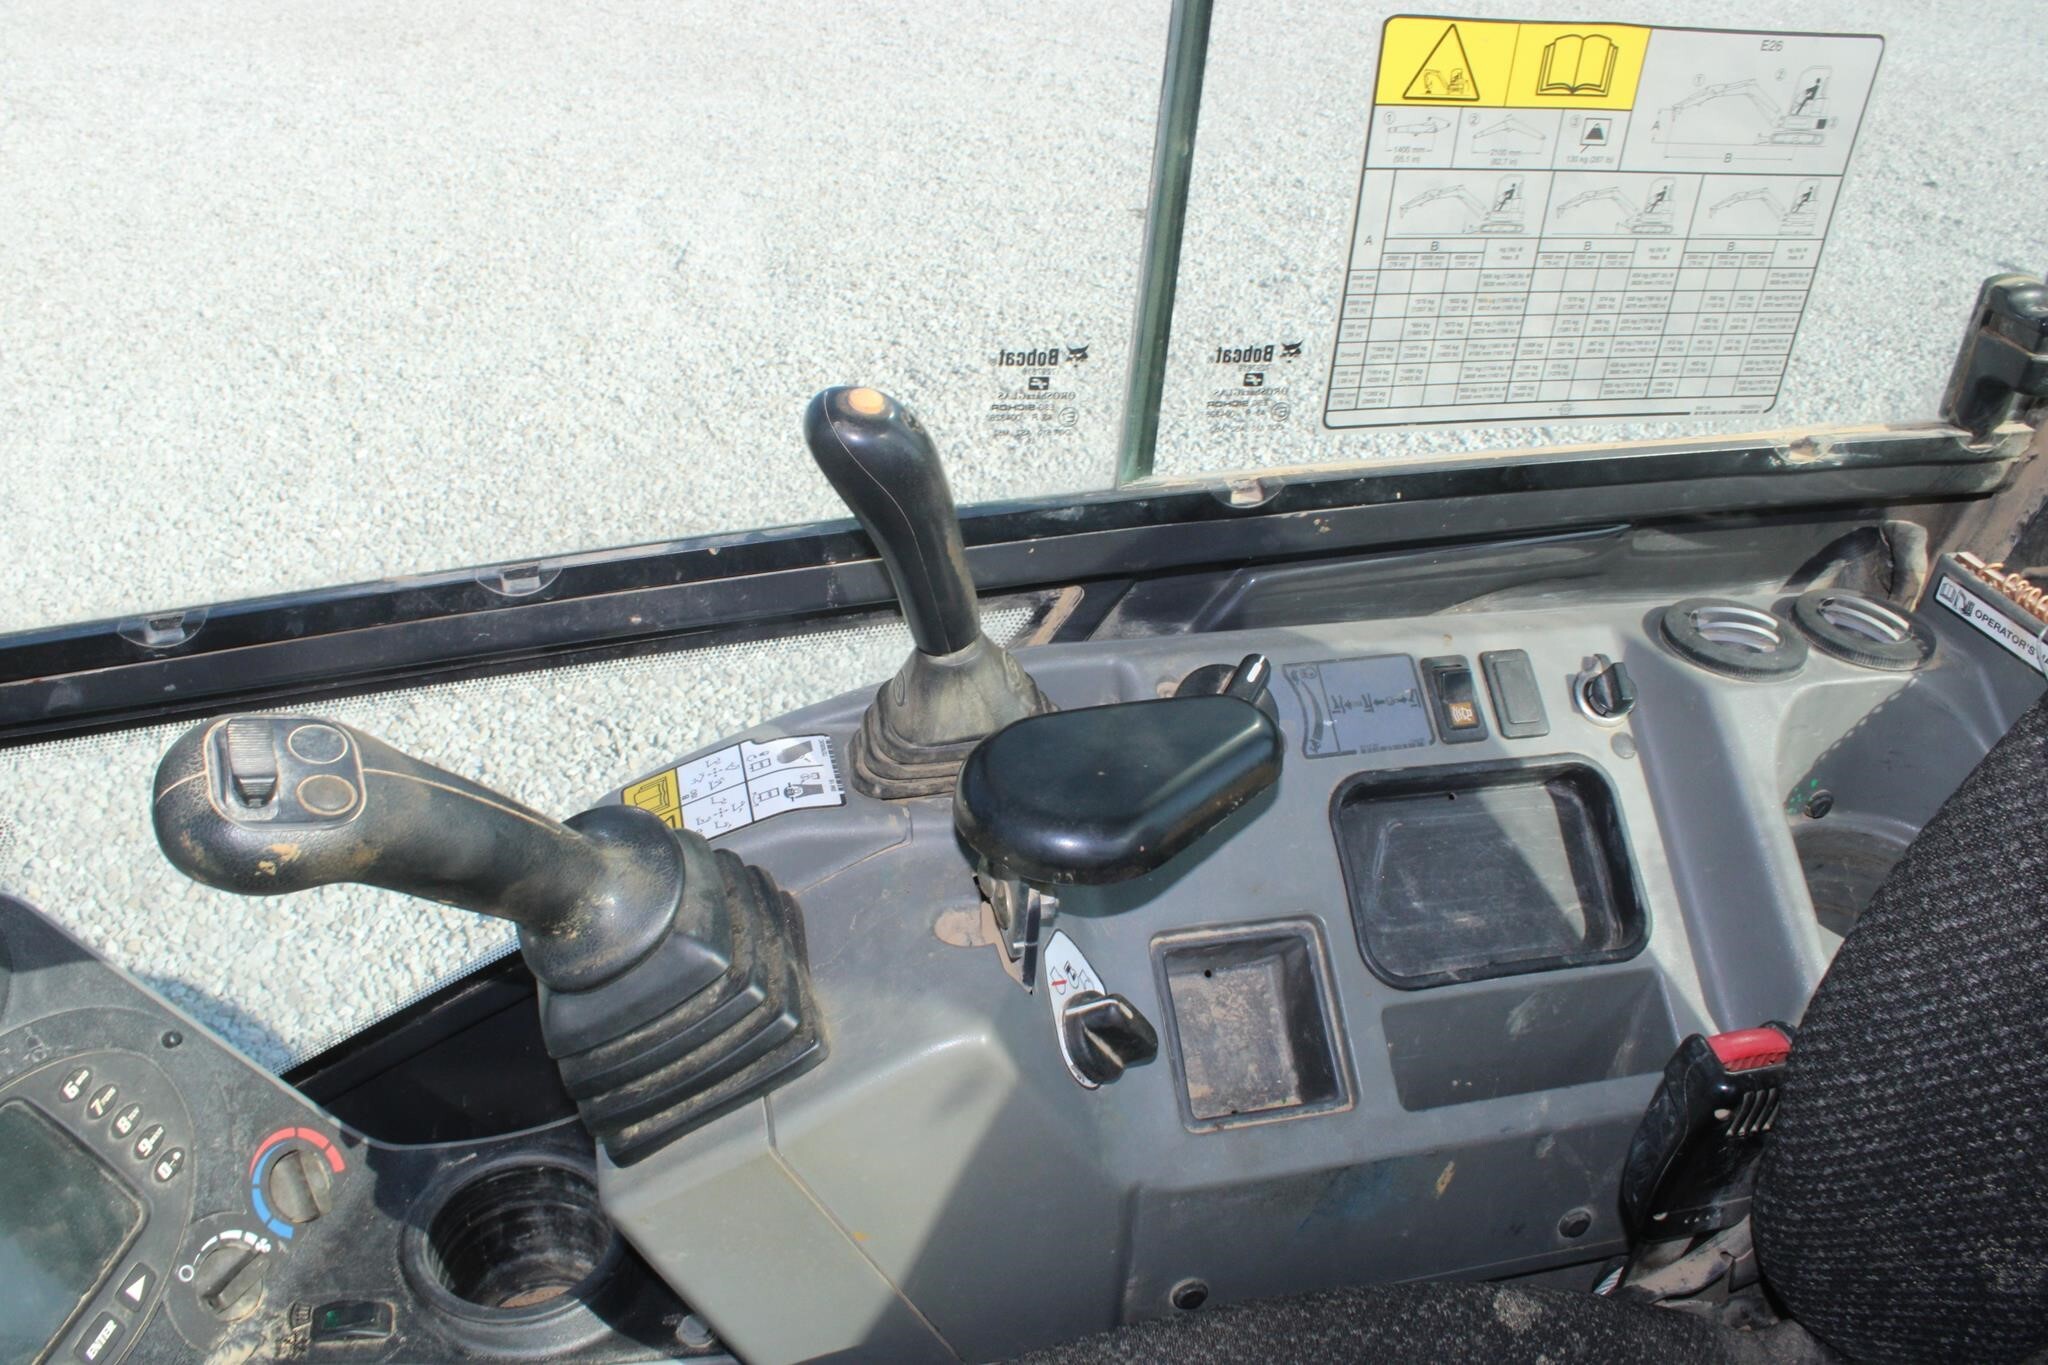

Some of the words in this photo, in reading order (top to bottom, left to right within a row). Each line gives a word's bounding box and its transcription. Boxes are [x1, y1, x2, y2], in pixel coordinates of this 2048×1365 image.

[1759, 39, 1785, 52] E26
[1723, 152, 1732, 162] B
[1364, 236, 1373, 245] A
[1430, 241, 1440, 250] B
[1583, 241, 1592, 250] B
[1726, 241, 1735, 250] B
[1975, 609, 2036, 656] OPERATOR'S
[64, 1080, 79, 1099] 6
[90, 1098, 104, 1116] 7
[116, 1116, 132, 1134] 8
[138, 1138, 153, 1157] 9
[157, 1161, 173, 1180] 0
[86, 1319, 118, 1361] ENTER
